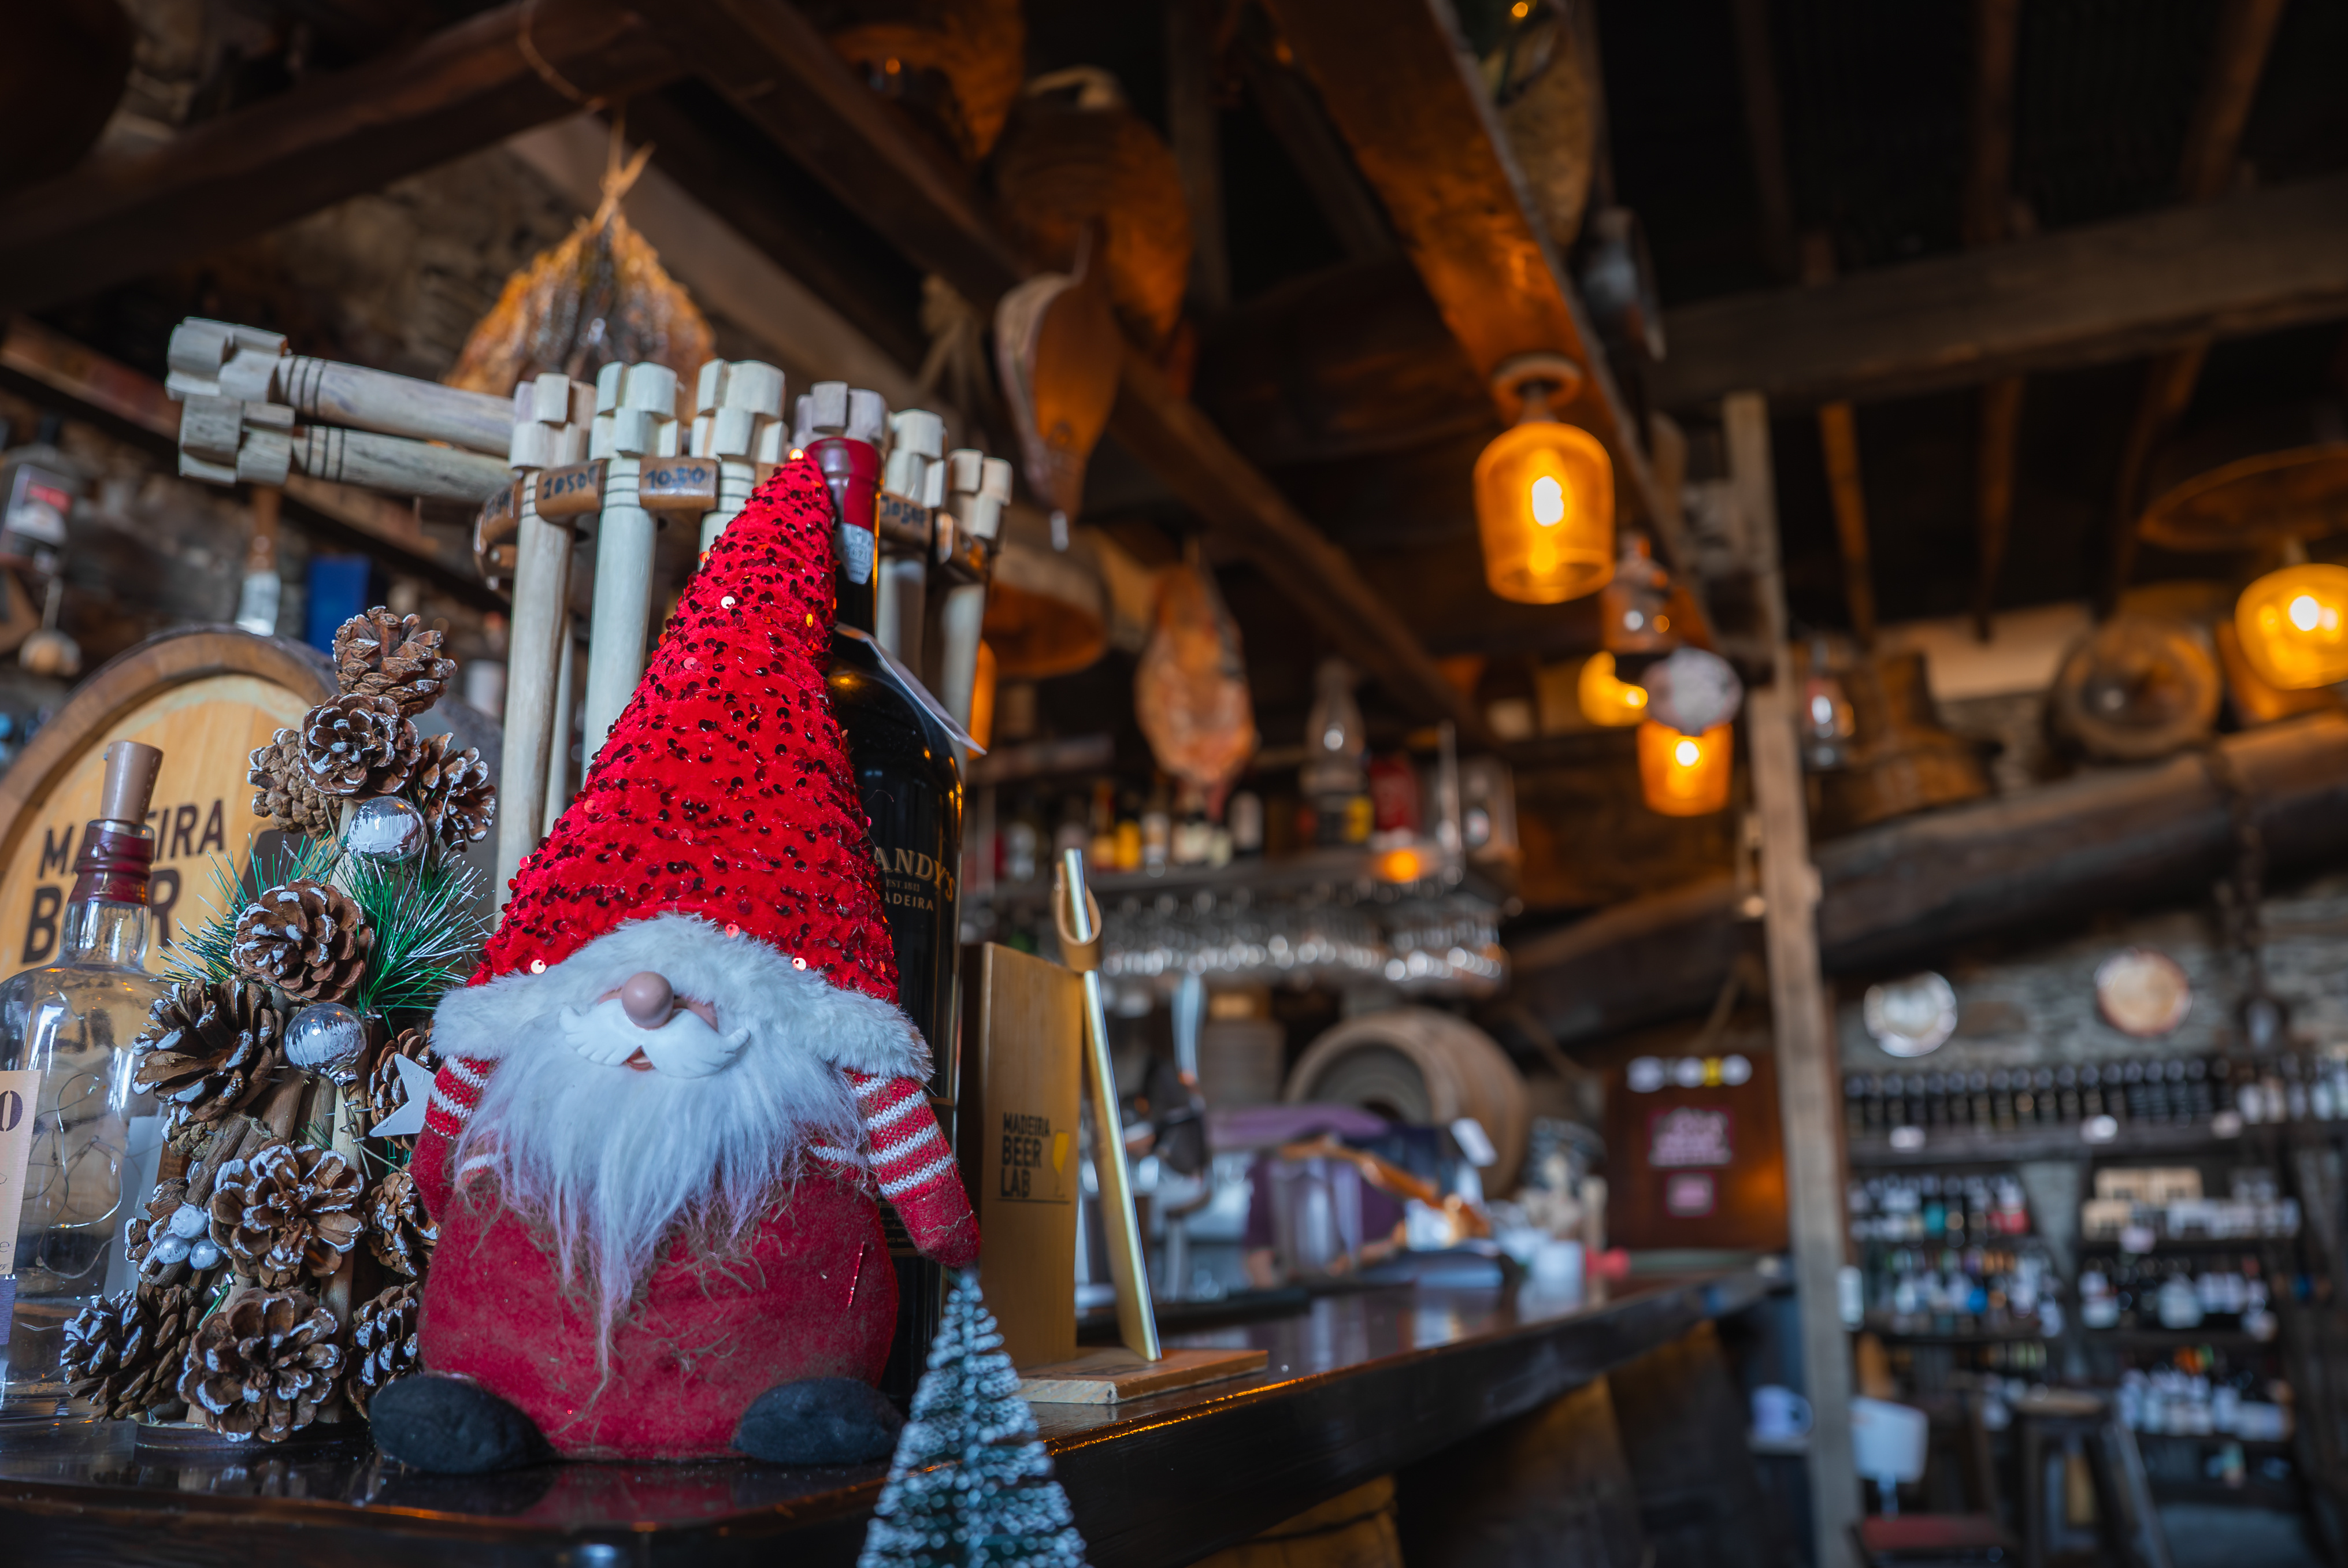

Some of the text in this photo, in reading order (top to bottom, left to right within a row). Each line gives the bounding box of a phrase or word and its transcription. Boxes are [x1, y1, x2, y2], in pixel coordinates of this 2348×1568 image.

[39, 800, 224, 878] MIRA
[23, 868, 180, 963] BR
[1003, 1112, 1051, 1138] MADEIRA
[1002, 1135, 1043, 1168] BEER
[1000, 1168, 1031, 1198] LAB
